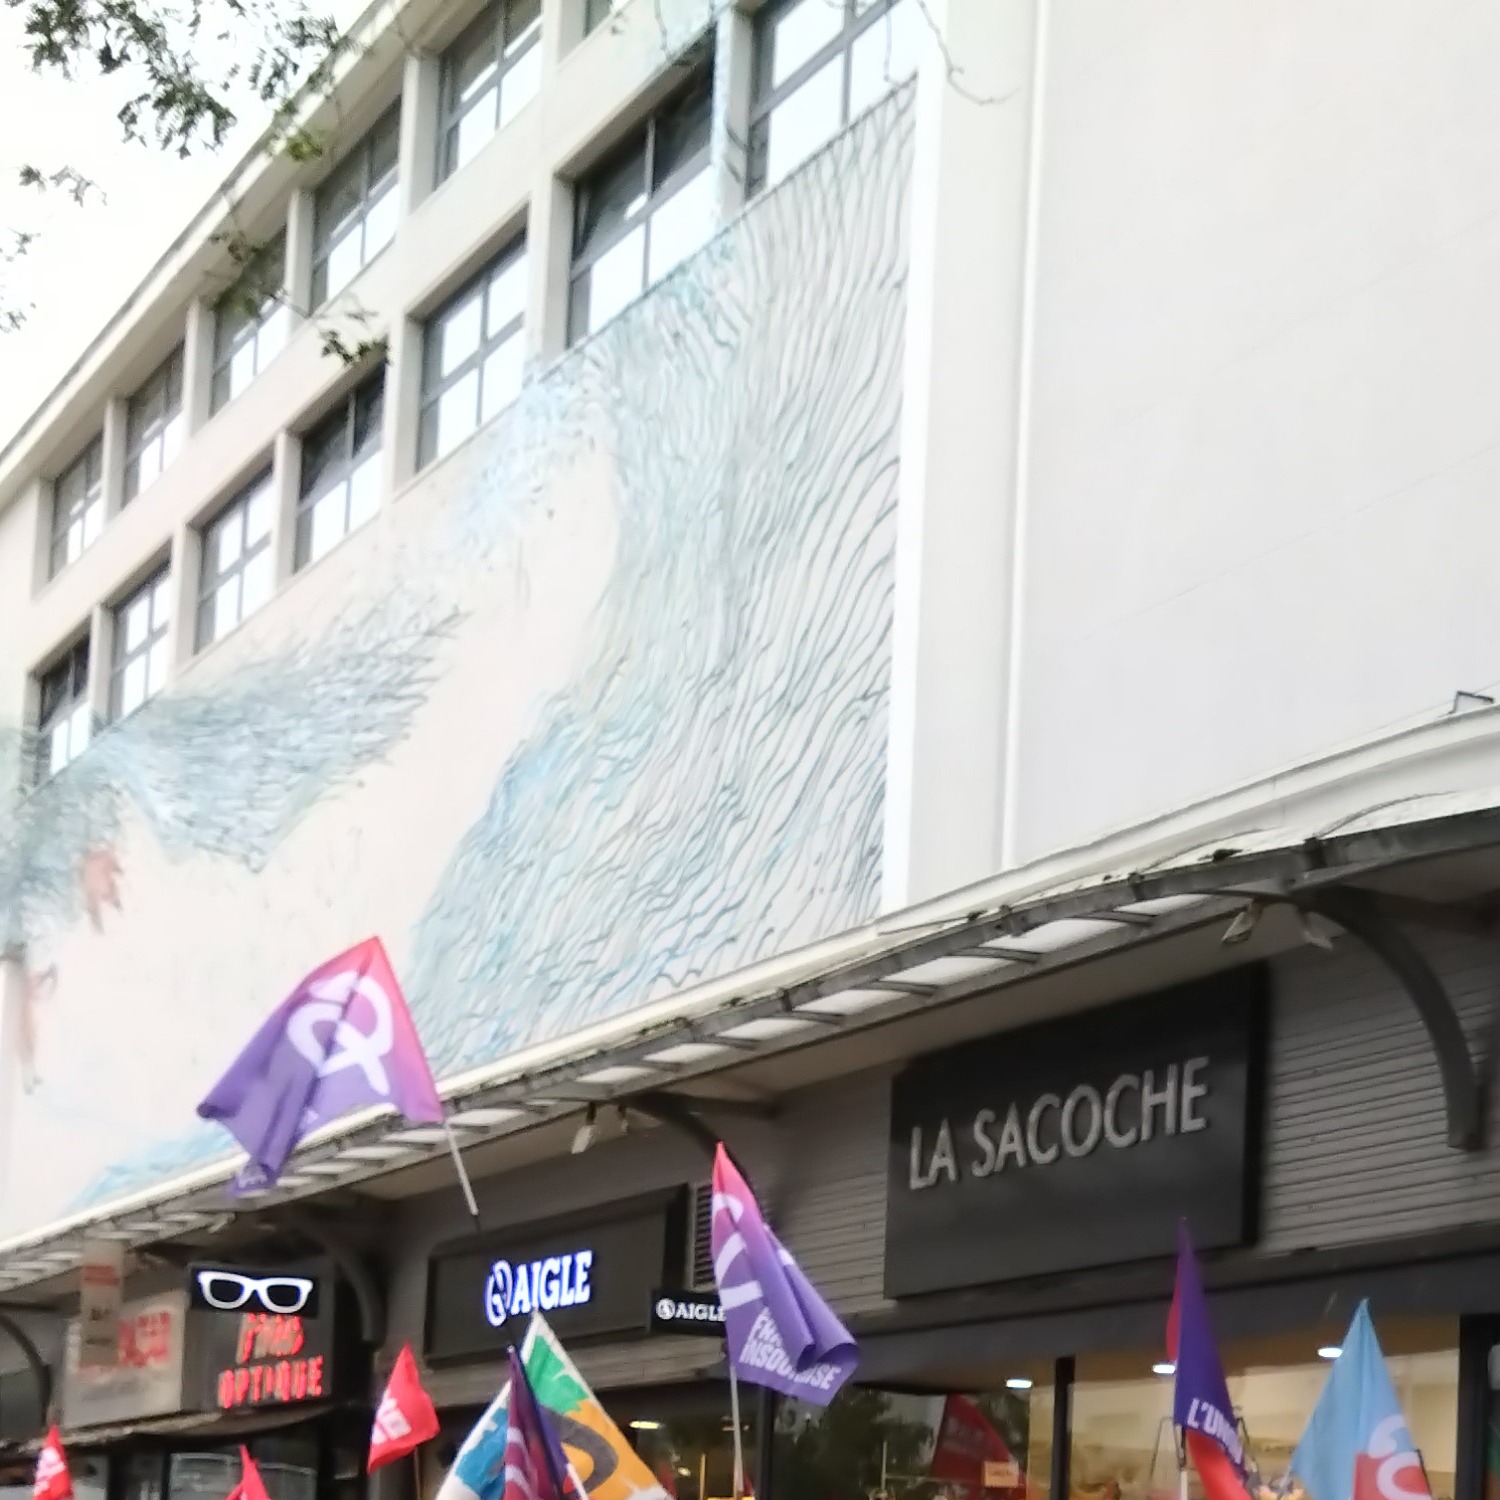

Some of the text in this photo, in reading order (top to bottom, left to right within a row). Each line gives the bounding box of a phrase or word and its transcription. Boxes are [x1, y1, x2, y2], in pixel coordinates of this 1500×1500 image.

[909, 1056, 1209, 1190] LA SACOCHE
[510, 1249, 594, 1316] AIGLE
[217, 1355, 325, 1410] OPTIQUE
